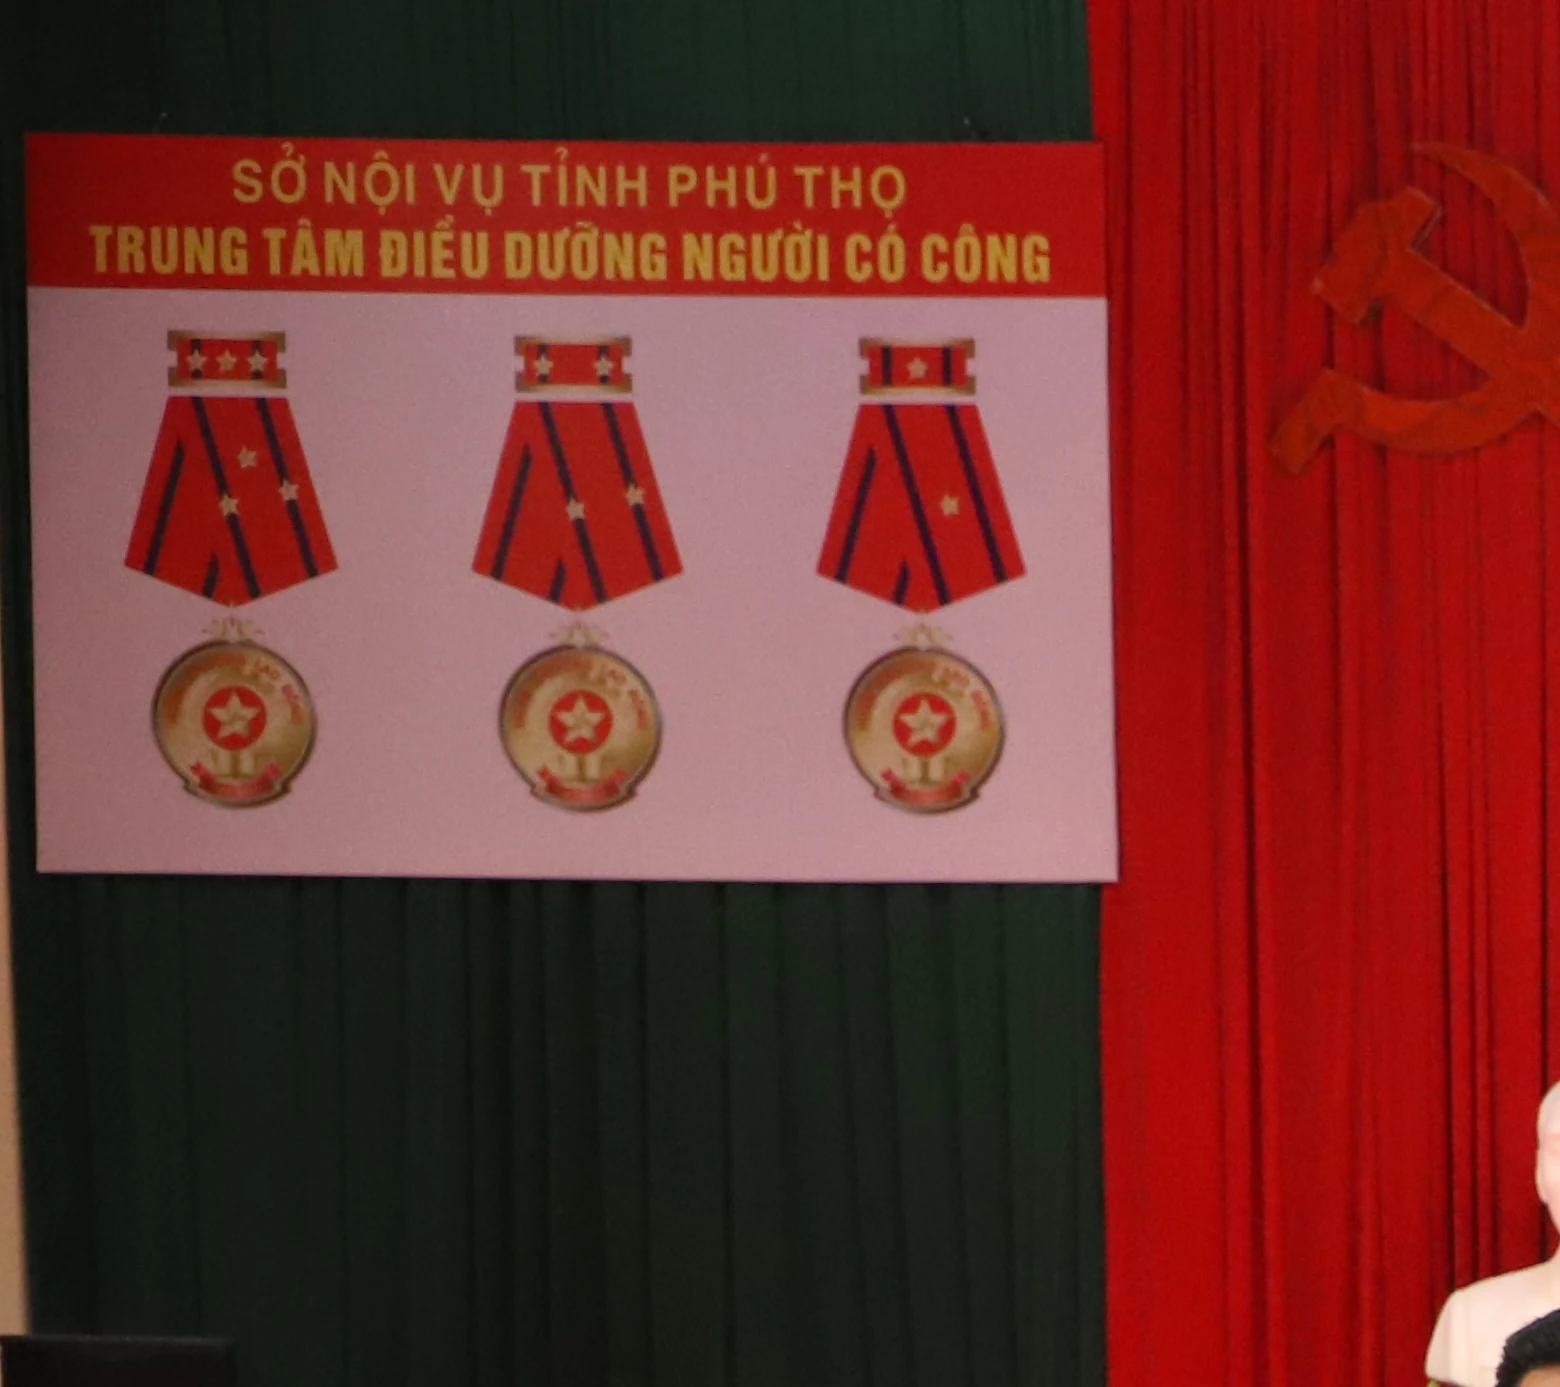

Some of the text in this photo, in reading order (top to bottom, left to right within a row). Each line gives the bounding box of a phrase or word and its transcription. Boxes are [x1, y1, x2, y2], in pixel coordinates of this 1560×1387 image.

[233, 142, 906, 218] SỞ NỘI VỤ TỈNH PHÚ THỌ
[89, 225, 248, 276] TRUNG
[263, 218, 364, 277] TÂM
[505, 220, 667, 281] DƯỠNG
[682, 220, 830, 282] NGƯỜI
[844, 222, 906, 282] CÓ
[921, 222, 1051, 283] CÔNG
